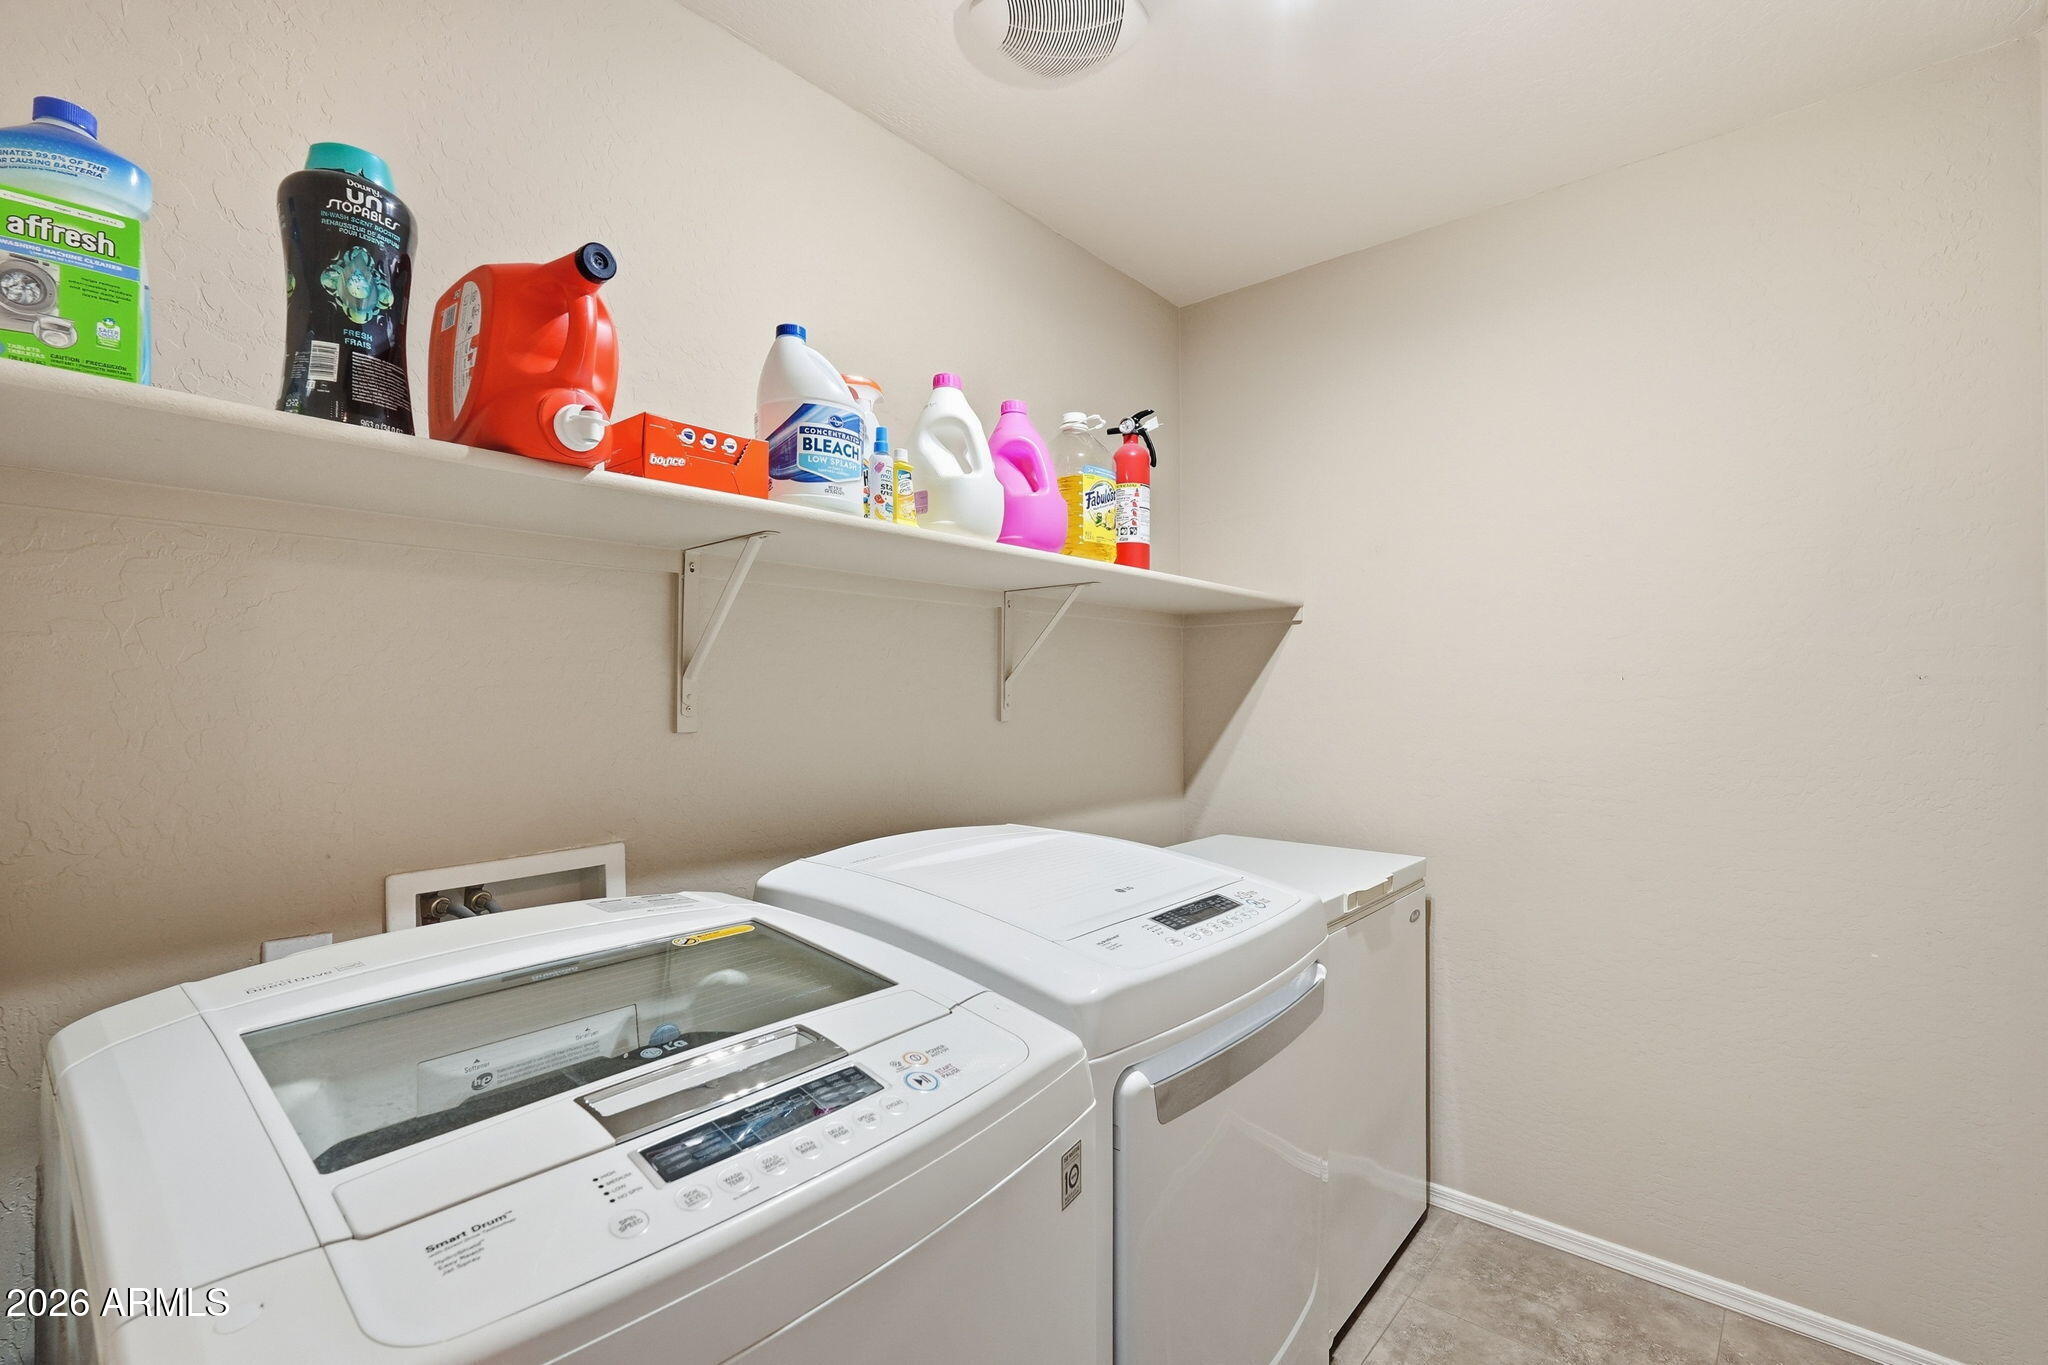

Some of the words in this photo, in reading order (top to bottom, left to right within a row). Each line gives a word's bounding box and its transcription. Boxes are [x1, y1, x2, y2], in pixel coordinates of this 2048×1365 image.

[0, 149, 33, 157] NATES
[36, 151, 67, 162] 99.9%
[69, 158, 83, 166] OF
[87, 163, 107, 173] THE
[10, 157, 51, 167] CAUSING
[54, 162, 103, 179] BACTERIA
[346, 179, 380, 198] Downy
[326, 198, 400, 231] STOPABLES
[5, 214, 116, 259] affresh
[43, 248, 83, 262] MACHINE
[84, 257, 122, 271] CLEANER
[343, 328, 373, 341] FRESH
[344, 337, 372, 350] FRAIS
[649, 452, 686, 467] bounce
[802, 437, 860, 461] BLEACH
[807, 455, 827, 464] LOW
[831, 457, 858, 471] SPLASH
[1085, 490, 1116, 510] Fabulos
[425, 1229, 468, 1254] Smart
